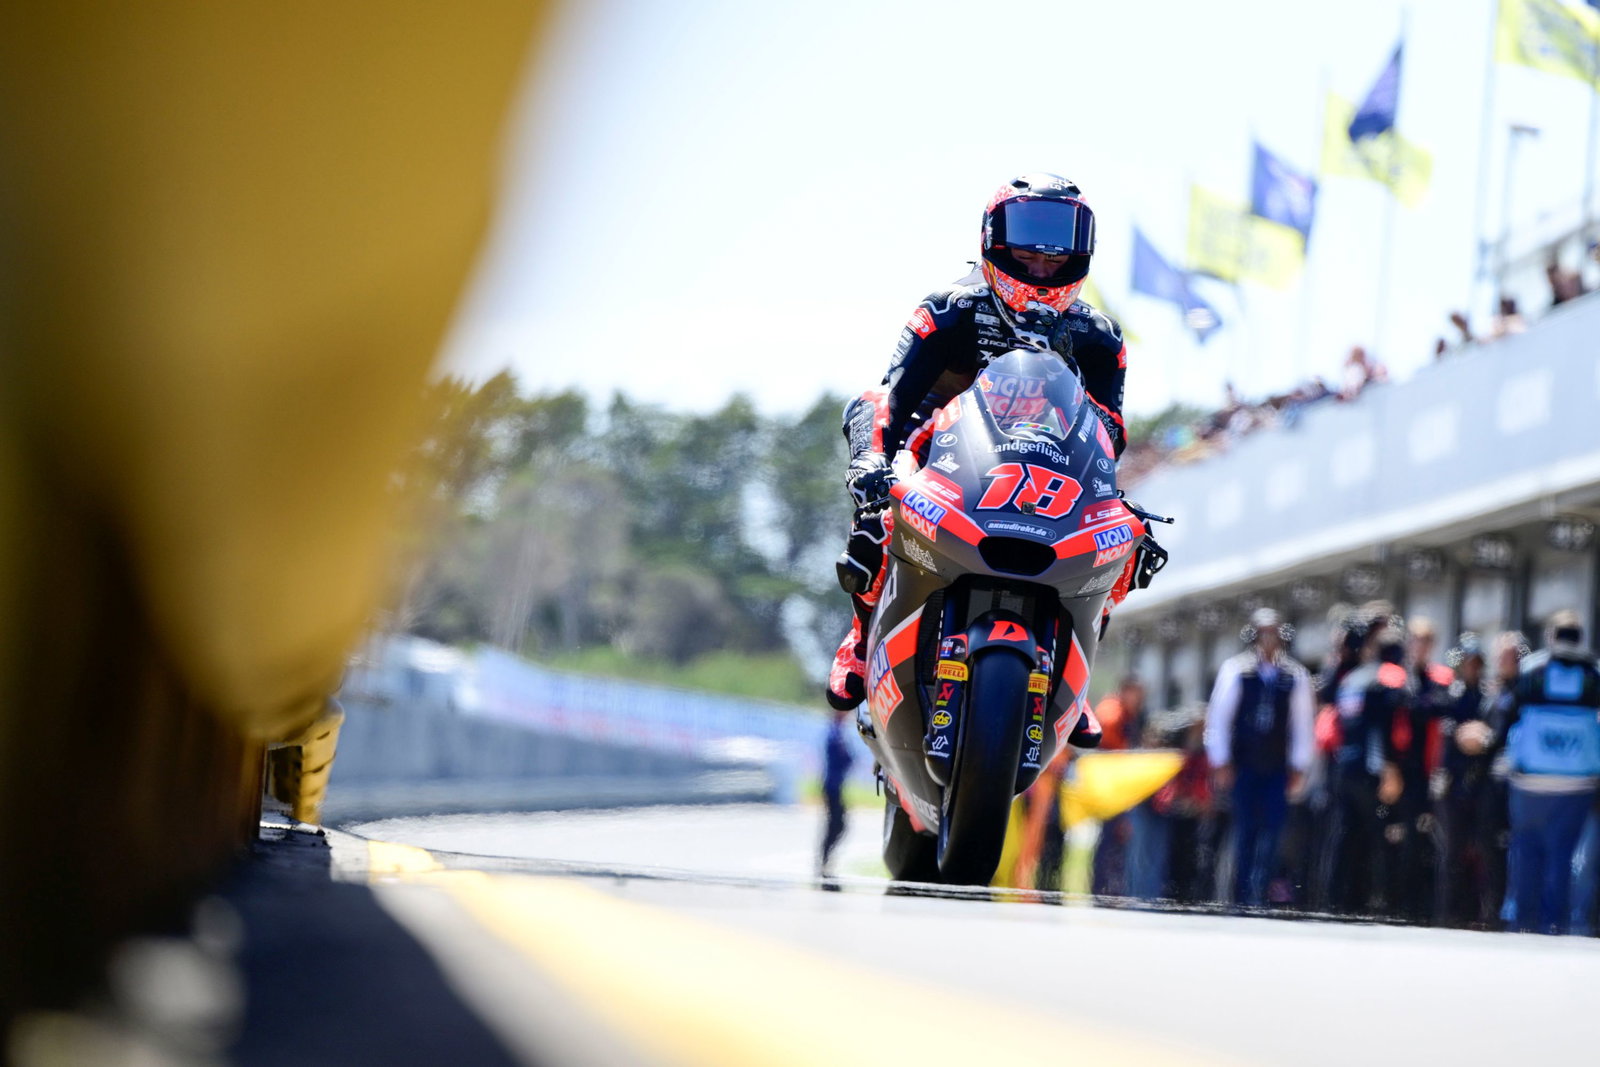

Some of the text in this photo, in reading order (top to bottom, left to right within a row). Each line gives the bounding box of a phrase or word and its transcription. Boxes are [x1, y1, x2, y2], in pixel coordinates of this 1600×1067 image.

[987, 439, 1070, 465] Landgeflügel
[977, 463, 1084, 519] 18
[903, 490, 945, 525] LIQUI
[1085, 506, 1124, 524] LS2
[902, 506, 936, 540] MOLY
[1096, 526, 1132, 550] LIQUI
[1095, 541, 1132, 567] MOLY
[933, 712, 950, 725] sbs
